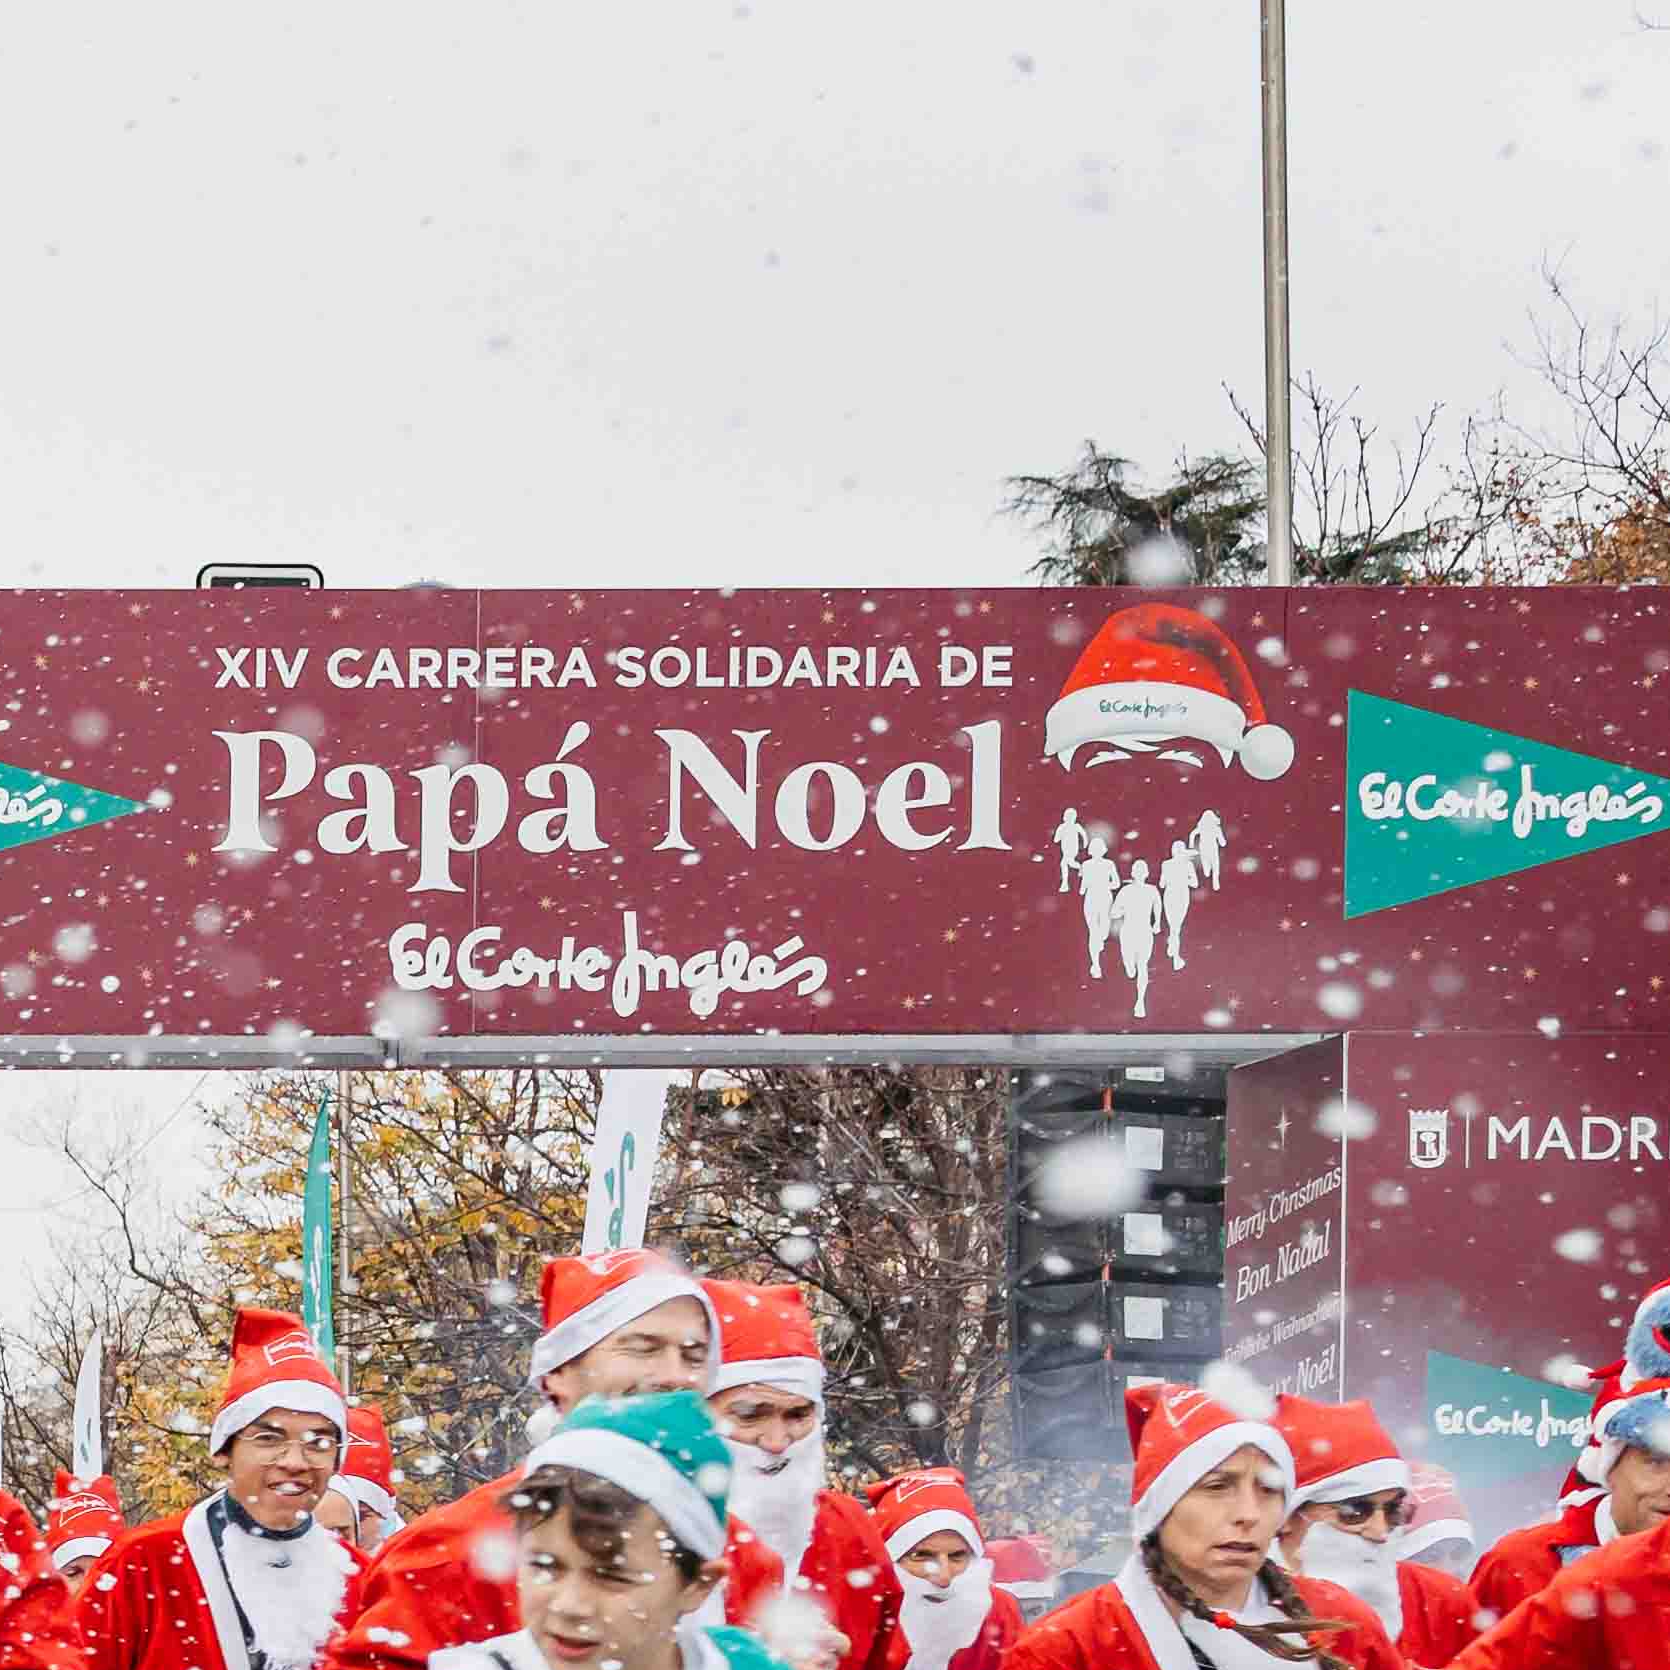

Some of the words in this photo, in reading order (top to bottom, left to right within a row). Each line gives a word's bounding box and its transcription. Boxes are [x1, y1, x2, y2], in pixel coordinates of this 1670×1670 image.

[216, 648, 308, 688] XIV
[328, 648, 596, 688] CARRERA
[608, 647, 920, 687] SOLIDARIA
[938, 647, 1012, 686] DE
[212, 721, 608, 892] Papá
[654, 719, 1012, 850] Noel
[1359, 772, 1403, 819] El
[1406, 775, 1508, 820] Corte
[1513, 765, 1663, 838] Inglés
[389, 923, 452, 990] El
[457, 926, 606, 991] Corte
[612, 911, 827, 1017] Inglés
[1487, 1116, 1666, 1160] MADR
[1227, 1210, 1266, 1249] Merry
[1269, 1166, 1341, 1223] Christmas
[1236, 1263, 1271, 1303] Bon
[1274, 1218, 1331, 1282] Nadal
[1296, 1343, 1336, 1397] Noël
[1435, 1403, 1465, 1435] El
[1466, 1404, 1533, 1436] Corte
